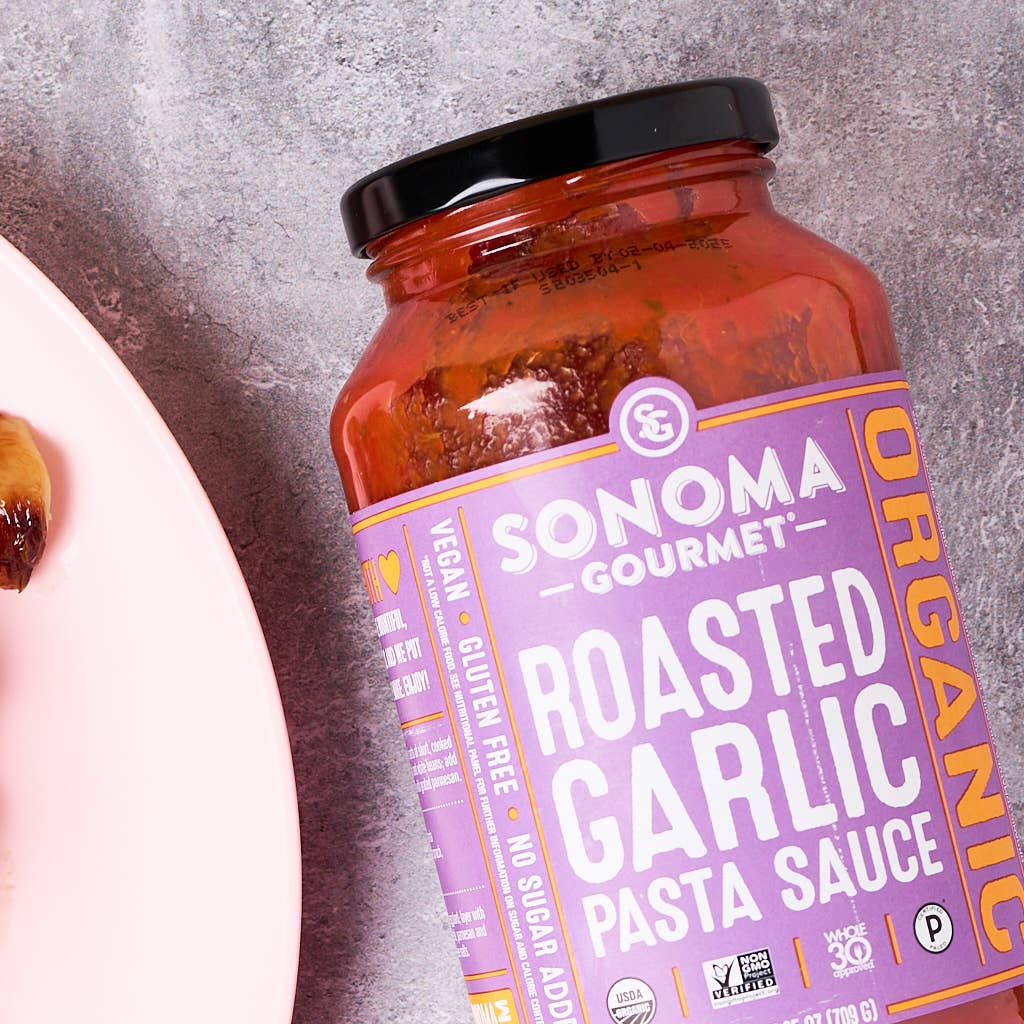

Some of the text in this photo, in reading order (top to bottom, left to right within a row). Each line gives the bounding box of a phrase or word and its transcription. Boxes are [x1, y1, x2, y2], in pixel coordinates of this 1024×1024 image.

[445, 295, 489, 324] BEST
[501, 278, 521, 296] IF
[532, 260, 580, 283] USED
[492, 437, 846, 575] SONOMA
[430, 517, 471, 602] VEGAN
[425, 577, 434, 586] A
[427, 587, 439, 608] LOW
[433, 609, 449, 646] CALORIE
[405, 637, 422, 662] PUT
[517, 566, 886, 757] ROASTED
[449, 673, 460, 689] SEE
[458, 635, 502, 729] GLUTEN
[863, 404, 1024, 954] ORGANIC
[453, 690, 474, 747] NUTRITIONAL
[468, 748, 482, 776] PANEL
[482, 735, 519, 796] FREE
[475, 777, 487, 796] FOR
[551, 683, 922, 884] GARLIC
[480, 796, 496, 834] FURTHER
[490, 834, 511, 893] INFORMATION
[507, 832, 536, 869] NO
[583, 811, 944, 958] PASTA SAUCE
[508, 909, 523, 940] SUGAR
[517, 874, 558, 957] SUGAR
[925, 914, 943, 943] P
[823, 922, 868, 943] WHOLE
[516, 940, 528, 960] AND
[740, 951, 768, 965] NON
[742, 959, 771, 974] GMO
[828, 936, 873, 971] 30
[521, 960, 537, 997] CALORIE
[744, 967, 772, 980] Project
[833, 960, 875, 979] approved
[616, 988, 644, 1003] USDA
[713, 978, 774, 1000] VERIFIED
[860, 998, 879, 1023] G)
